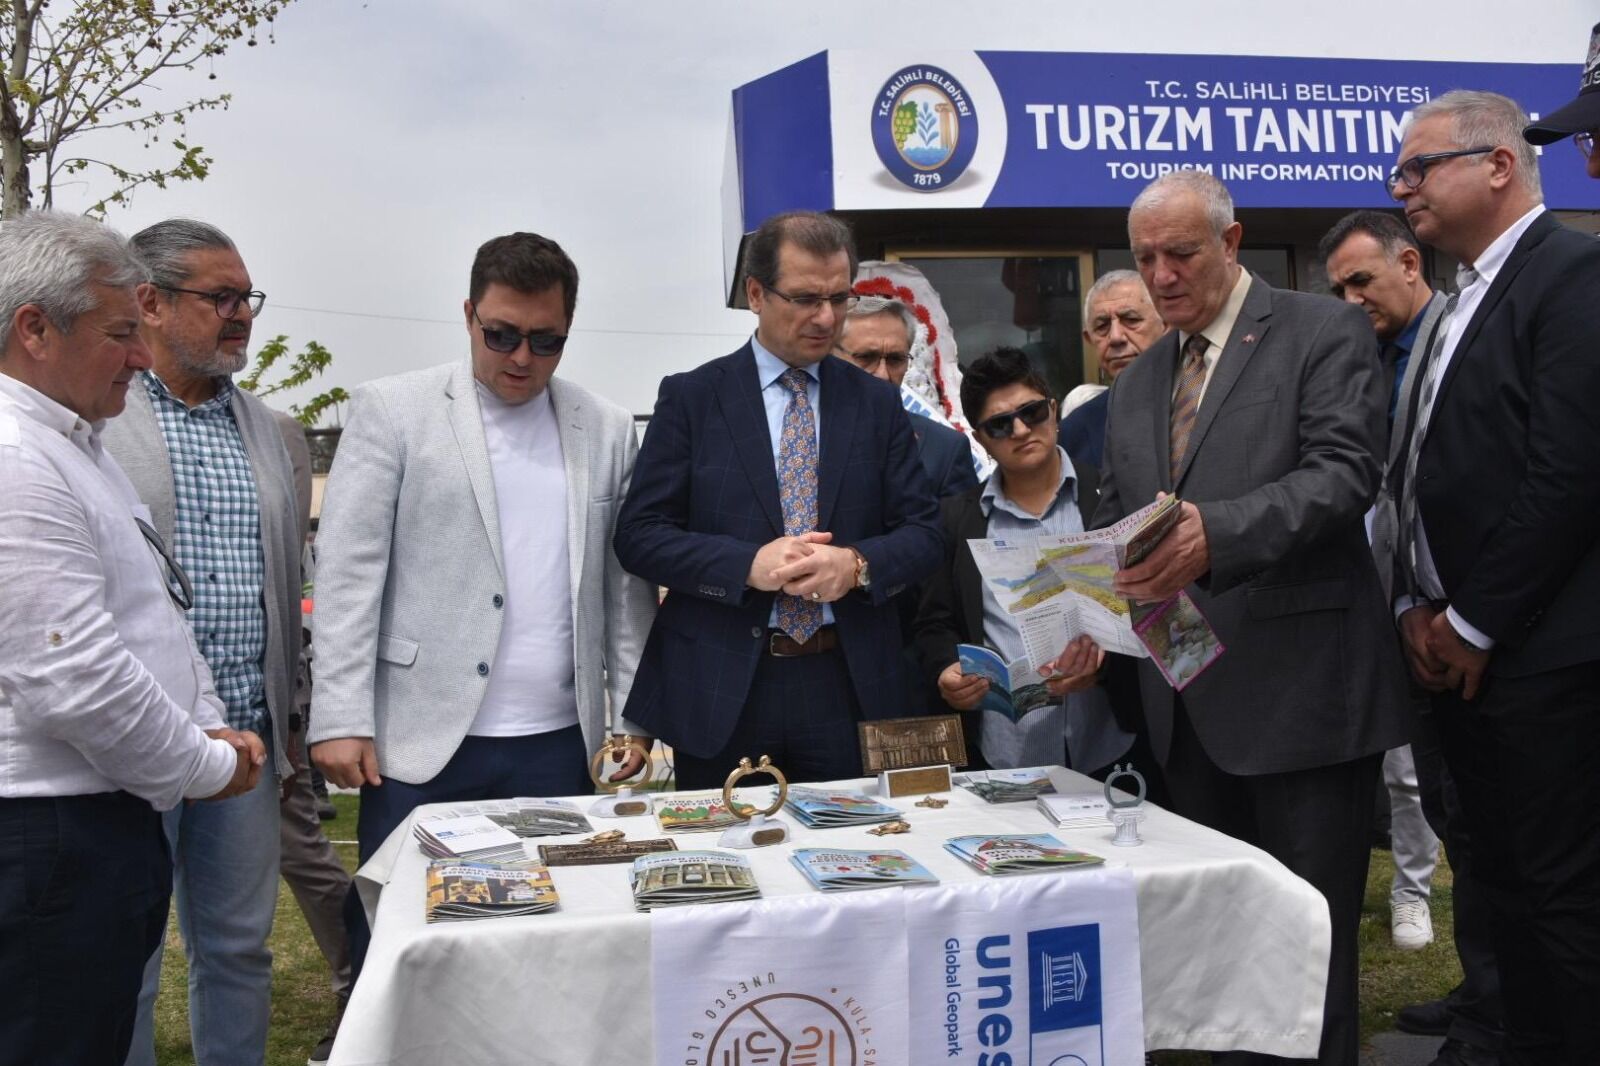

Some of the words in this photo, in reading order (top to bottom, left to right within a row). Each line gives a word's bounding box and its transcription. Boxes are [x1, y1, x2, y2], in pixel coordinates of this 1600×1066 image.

[1145, 80, 1188, 99] T.C.
[913, 173, 941, 185] 1879
[1221, 163, 1384, 181] INFORMATION
[945, 938, 961, 988] Global
[944, 991, 962, 1057] Geopark
